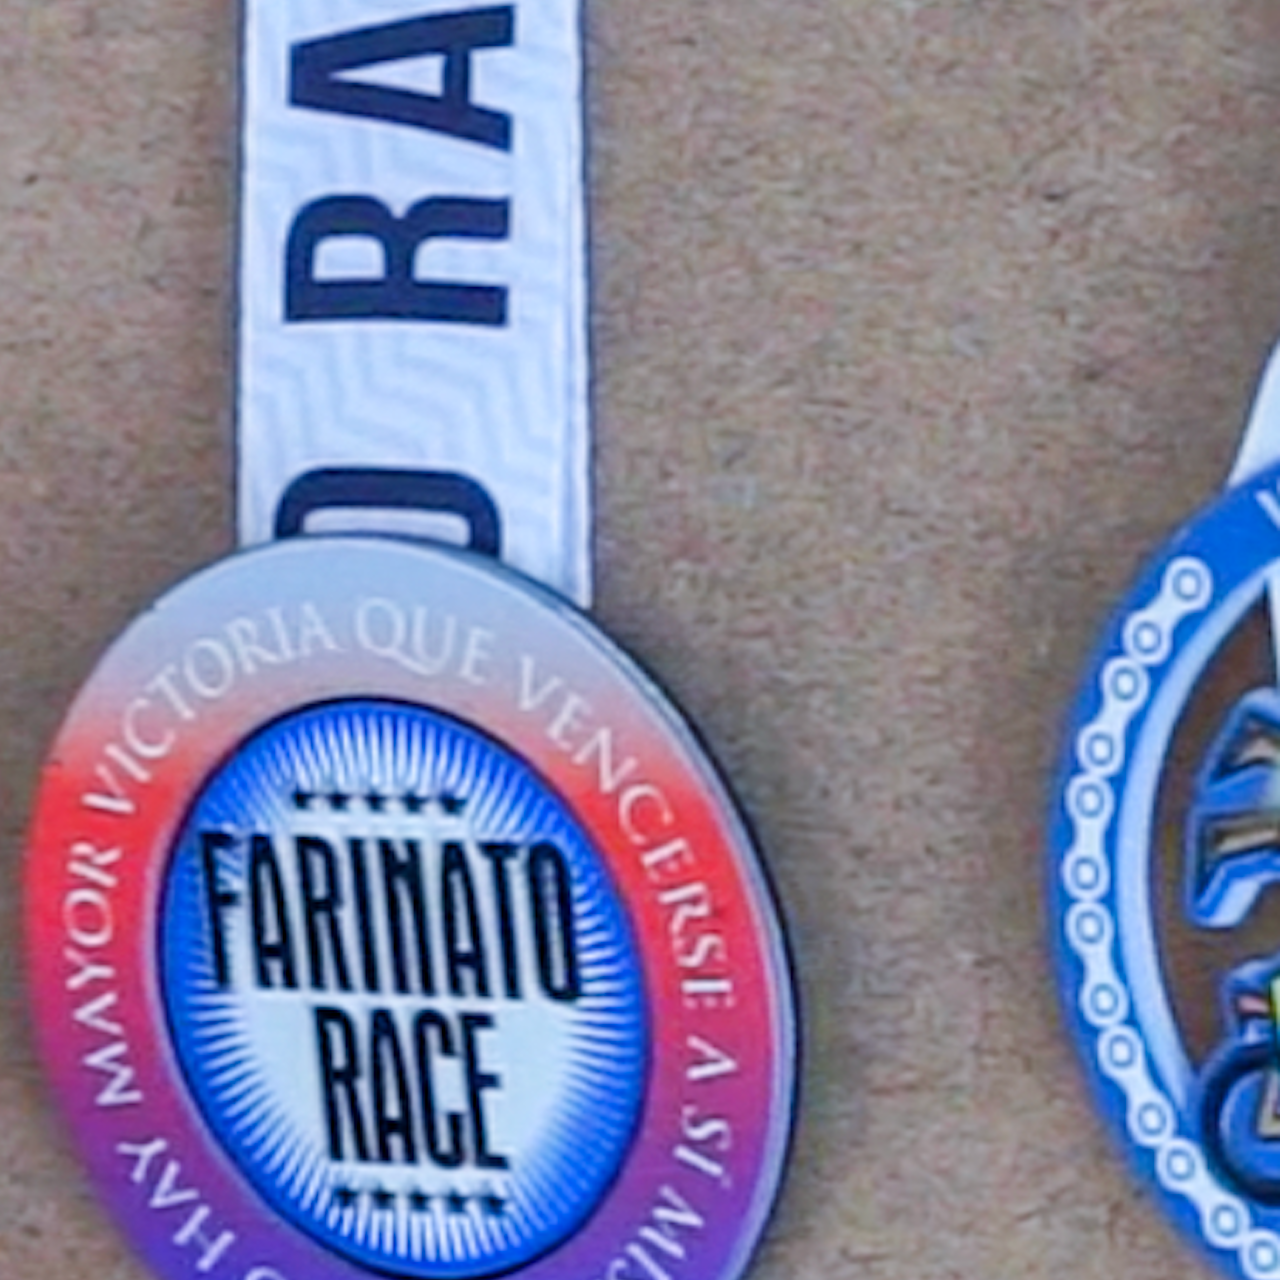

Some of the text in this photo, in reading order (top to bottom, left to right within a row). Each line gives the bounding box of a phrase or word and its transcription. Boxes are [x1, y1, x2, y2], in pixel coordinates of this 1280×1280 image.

[82, 600, 338, 820] VICTORIA
[354, 596, 493, 684] QUE
[514, 653, 736, 1010] VENCERSE
[62, 840, 142, 1108] MAYOR
[197, 831, 585, 1006] FARINATO
[313, 1005, 510, 1171] RACE
[685, 1035, 738, 1081] A
[117, 1136, 236, 1274] HAY
